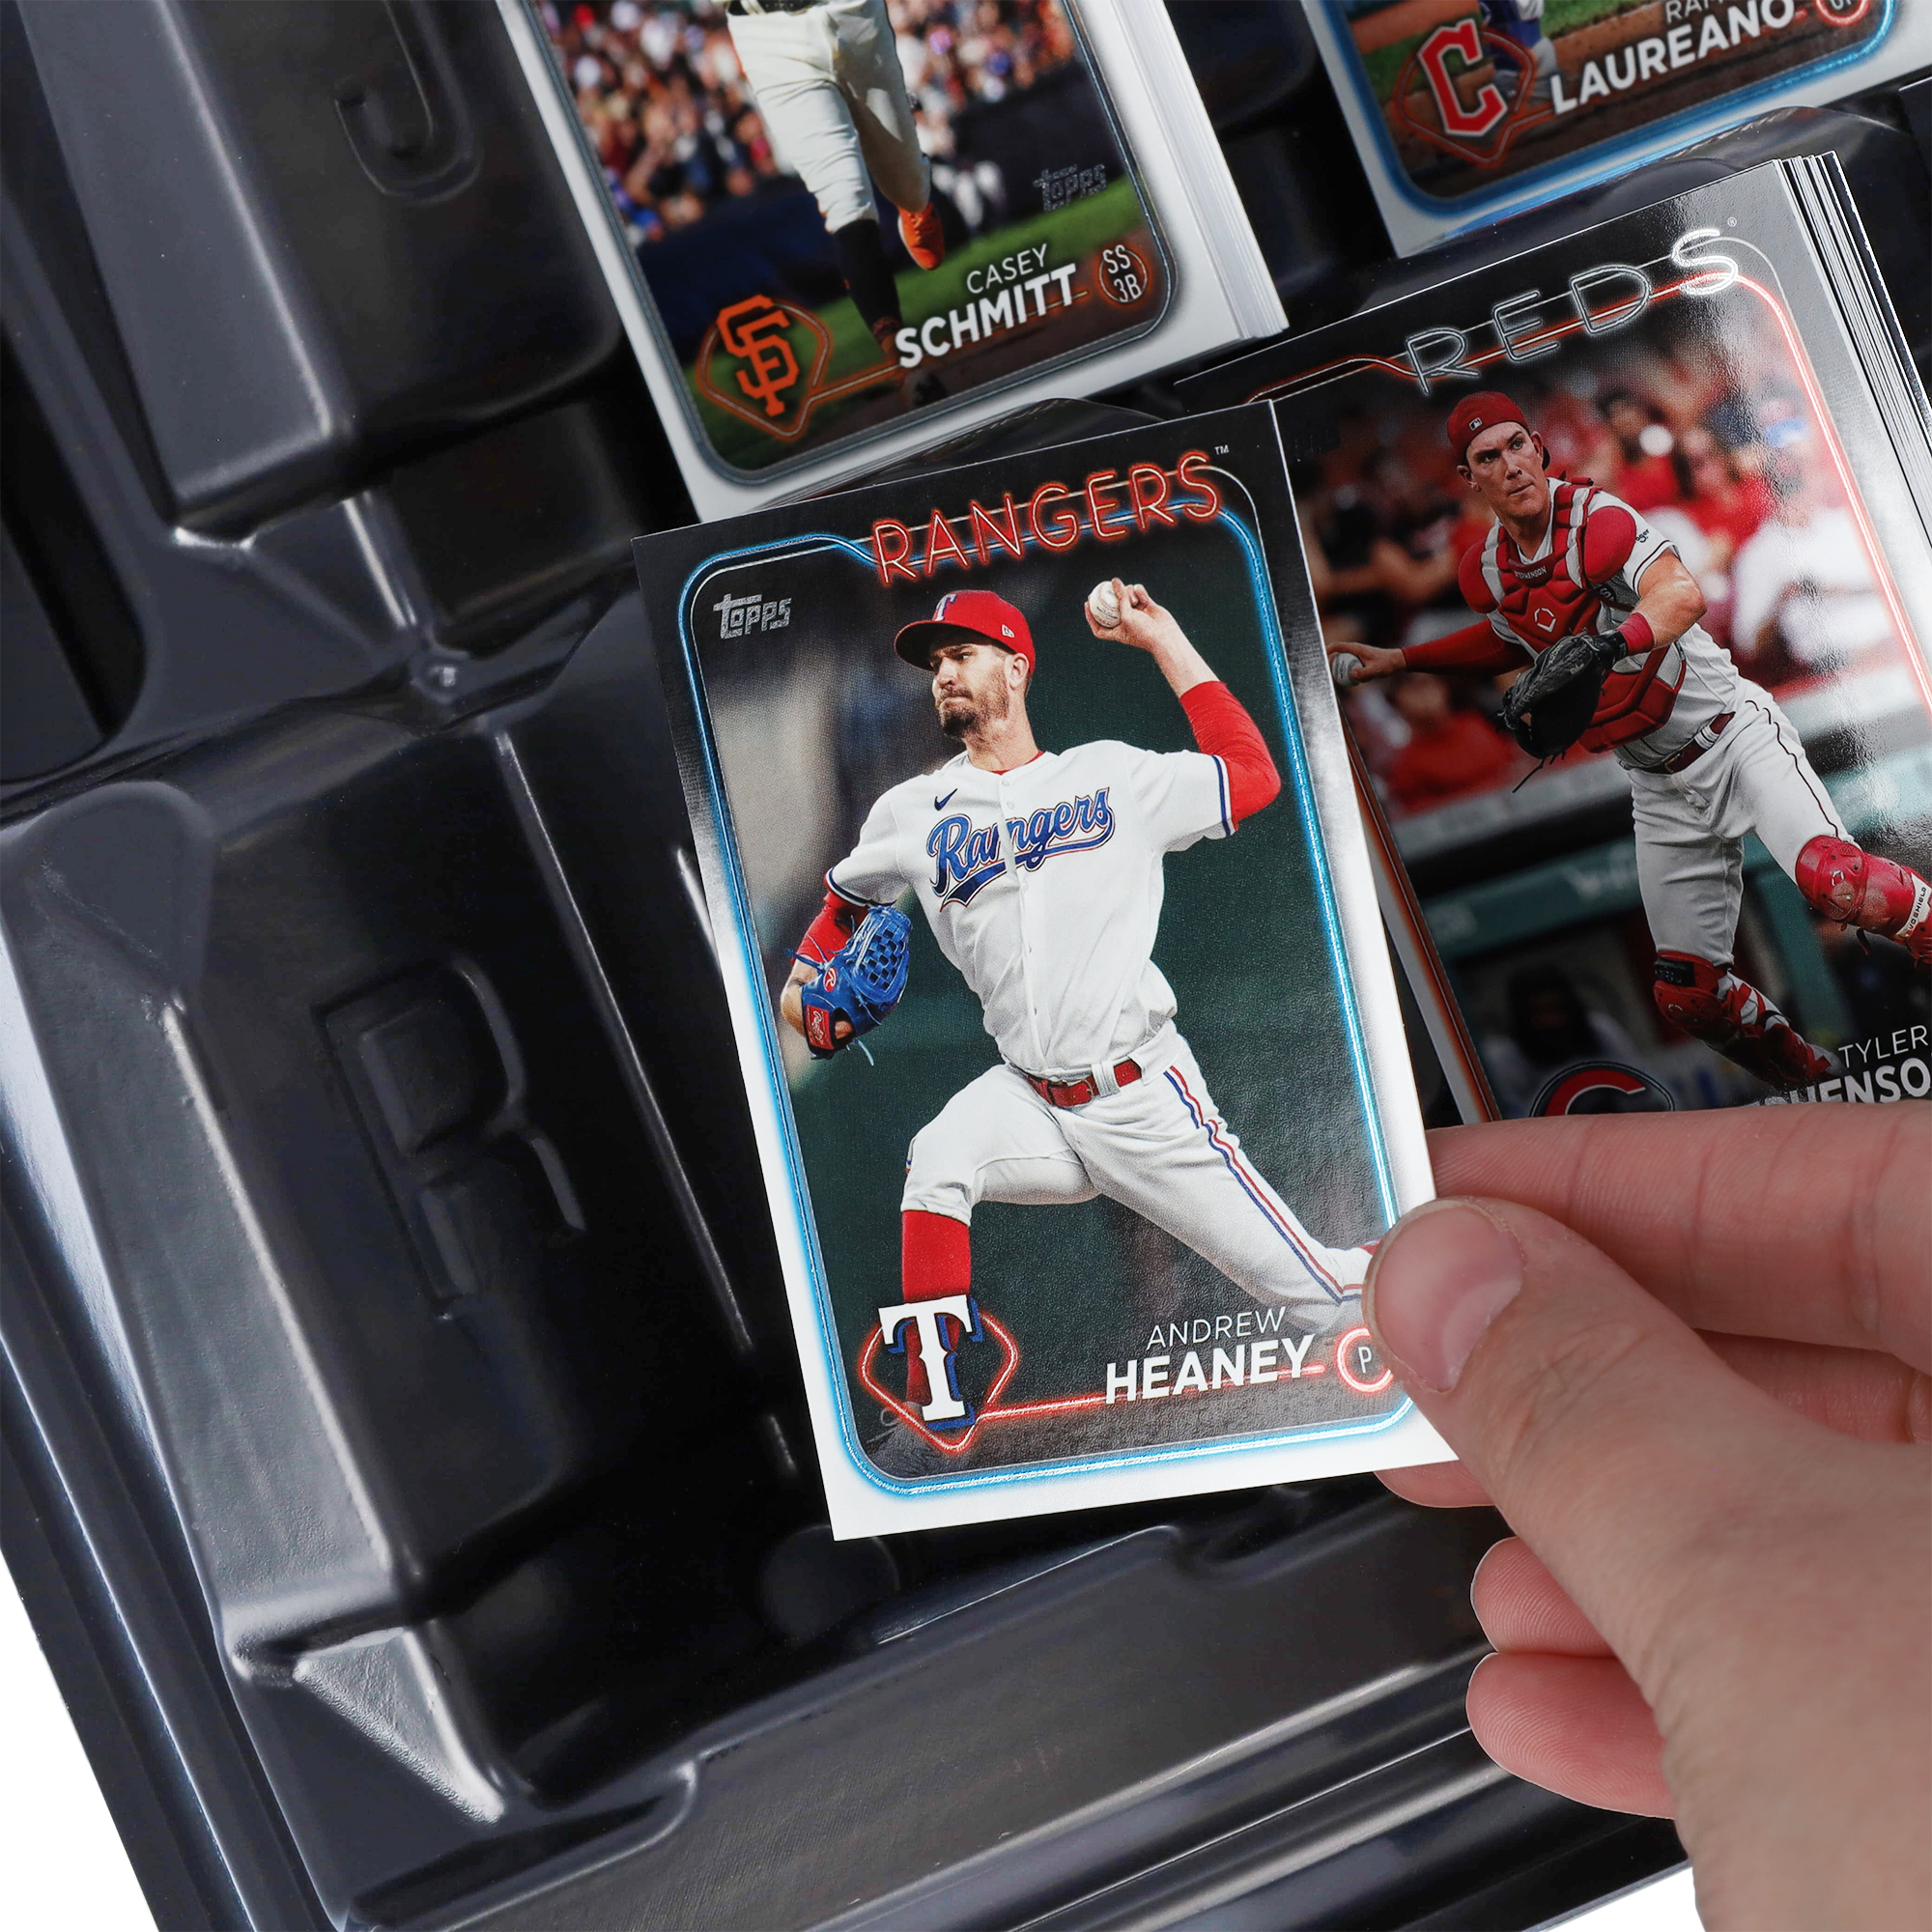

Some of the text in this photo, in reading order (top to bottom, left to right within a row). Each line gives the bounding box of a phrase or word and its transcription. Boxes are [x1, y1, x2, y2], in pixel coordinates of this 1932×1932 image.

[1549, 0, 1795, 115] LAUREANO
[966, 243, 1047, 294] CASEY
[1113, 273, 1143, 302] 3B
[895, 263, 1076, 368] SCHMITT
[1406, 228, 1740, 396] REDS
[872, 451, 1221, 585] RANGERS
[926, 786, 1116, 912] Rangers
[1837, 1025, 1929, 1068] TYLER
[1146, 1305, 1287, 1350] ANDREW
[1357, 1346, 1373, 1374] P
[1105, 1333, 1317, 1405] HEANEY
